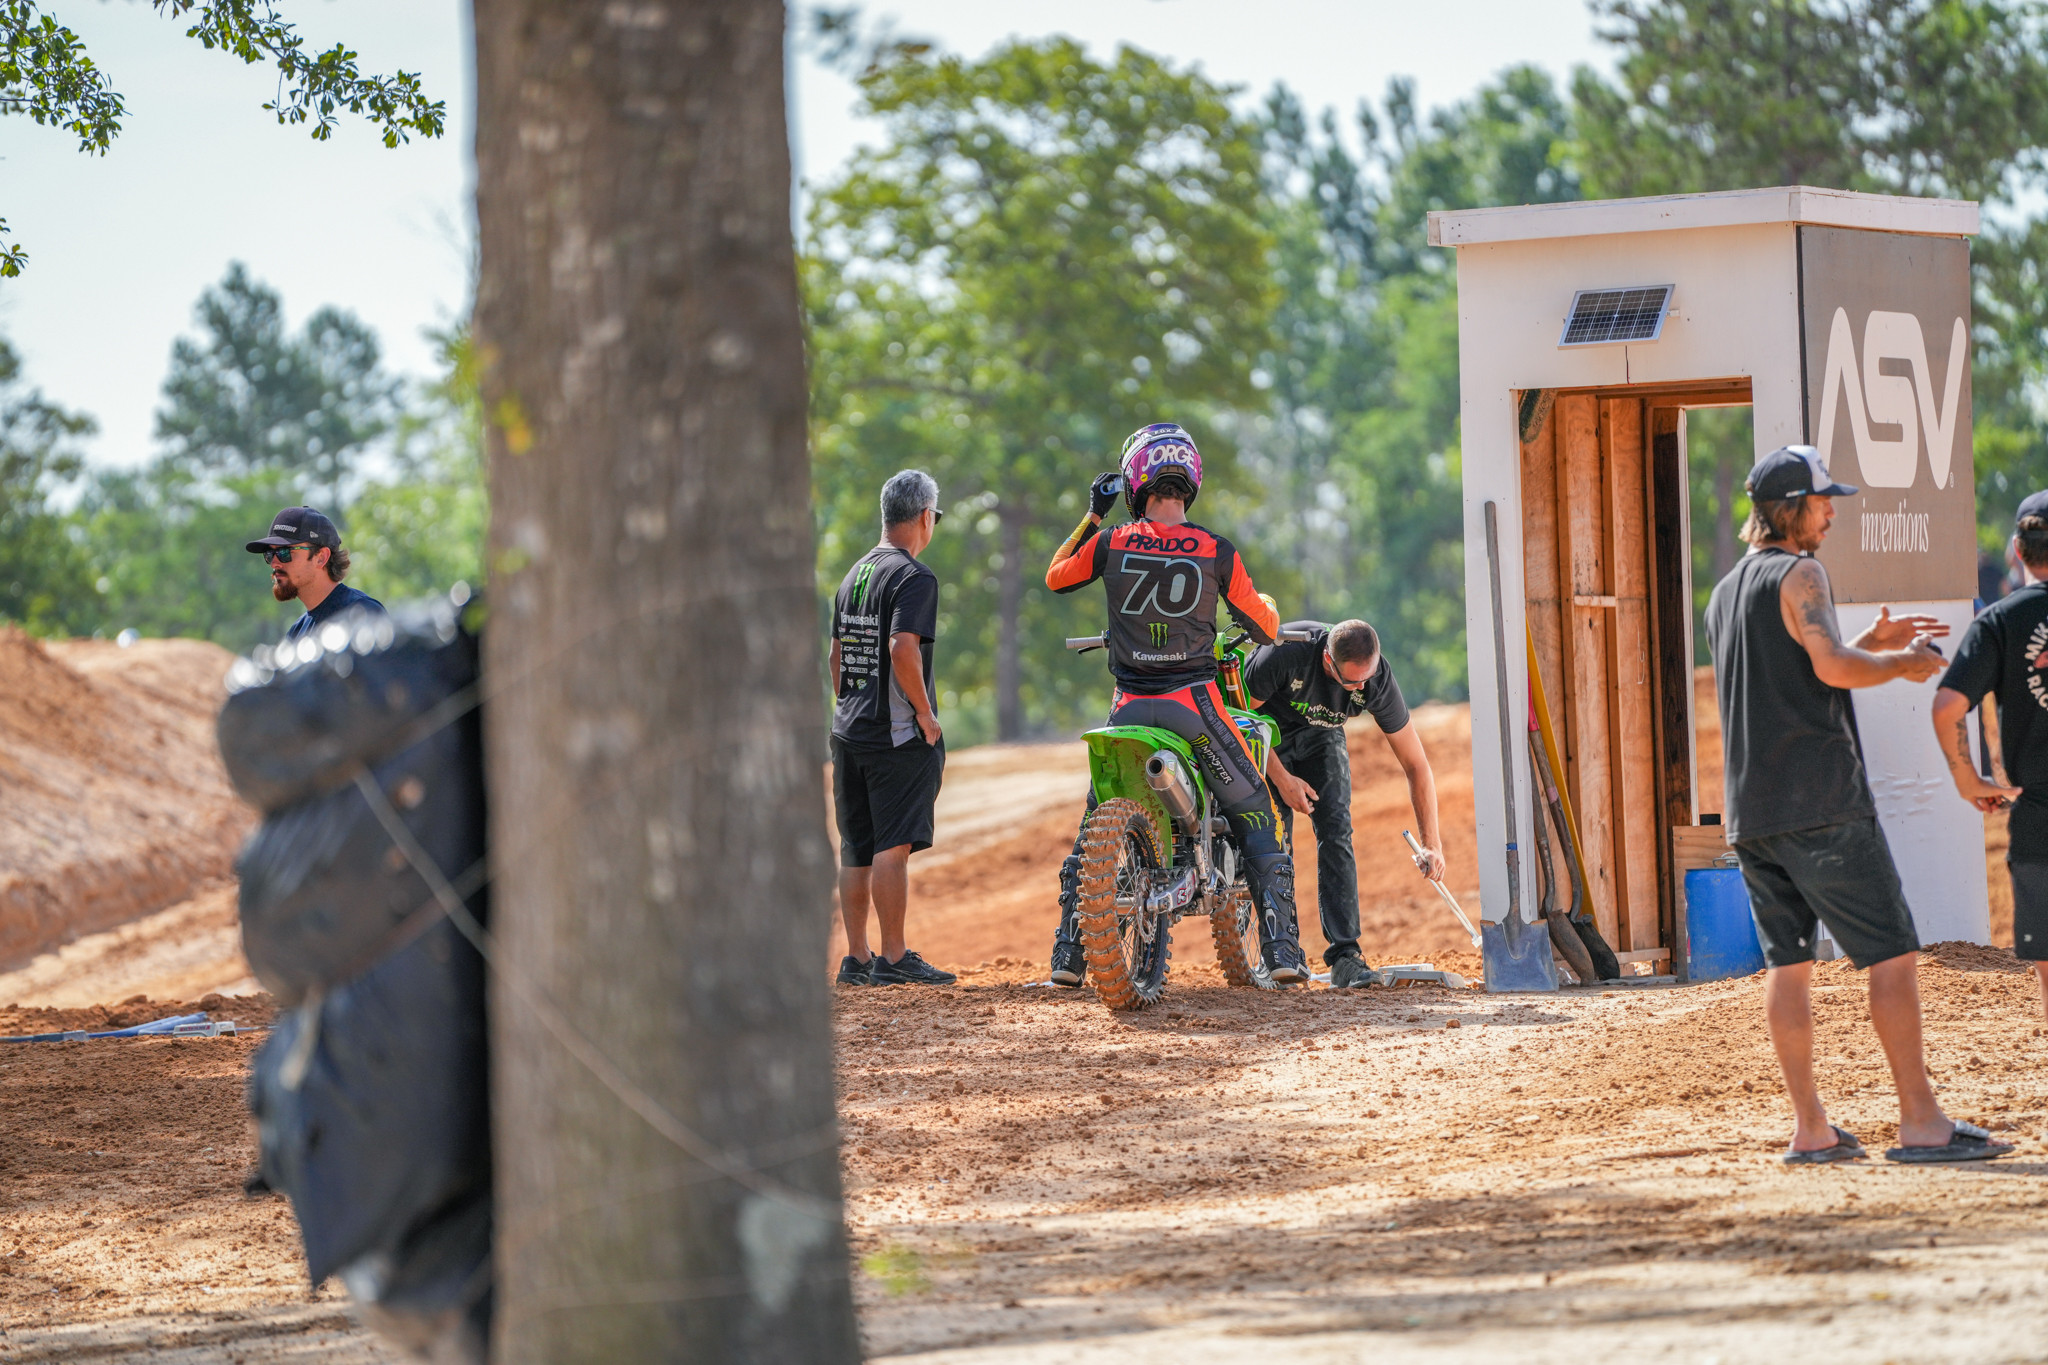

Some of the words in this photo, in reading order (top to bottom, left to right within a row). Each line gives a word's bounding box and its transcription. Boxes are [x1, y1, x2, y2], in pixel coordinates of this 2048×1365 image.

[1817, 306, 1967, 490] ASV
[1125, 533, 1199, 553] PRADO
[1861, 497, 1929, 553] inventions
[1121, 553, 1203, 618] 70
[1132, 651, 1187, 661] Kawasaki
[1308, 703, 1347, 719] MONSTE
[1201, 745, 1233, 785] MONSTER
